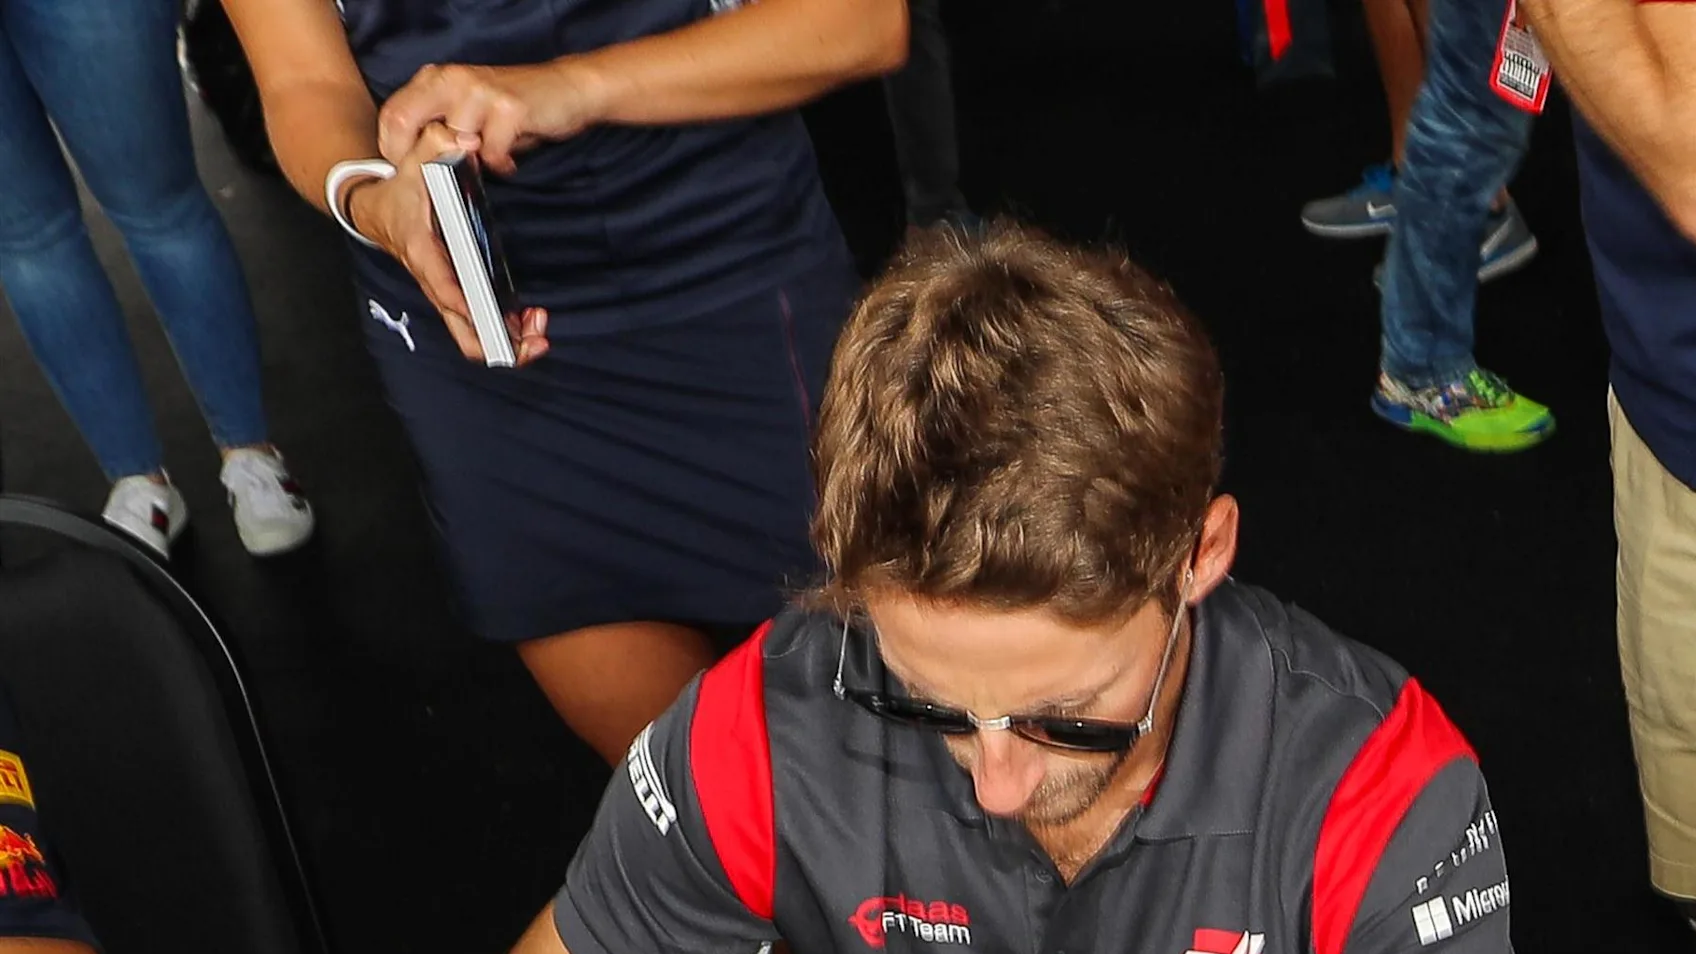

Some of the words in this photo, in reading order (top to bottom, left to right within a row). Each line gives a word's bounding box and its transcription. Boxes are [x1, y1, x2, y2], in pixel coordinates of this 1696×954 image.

[1452, 876, 1510, 925] Micro
[882, 911, 906, 933] F1
[908, 916, 971, 945] Team
